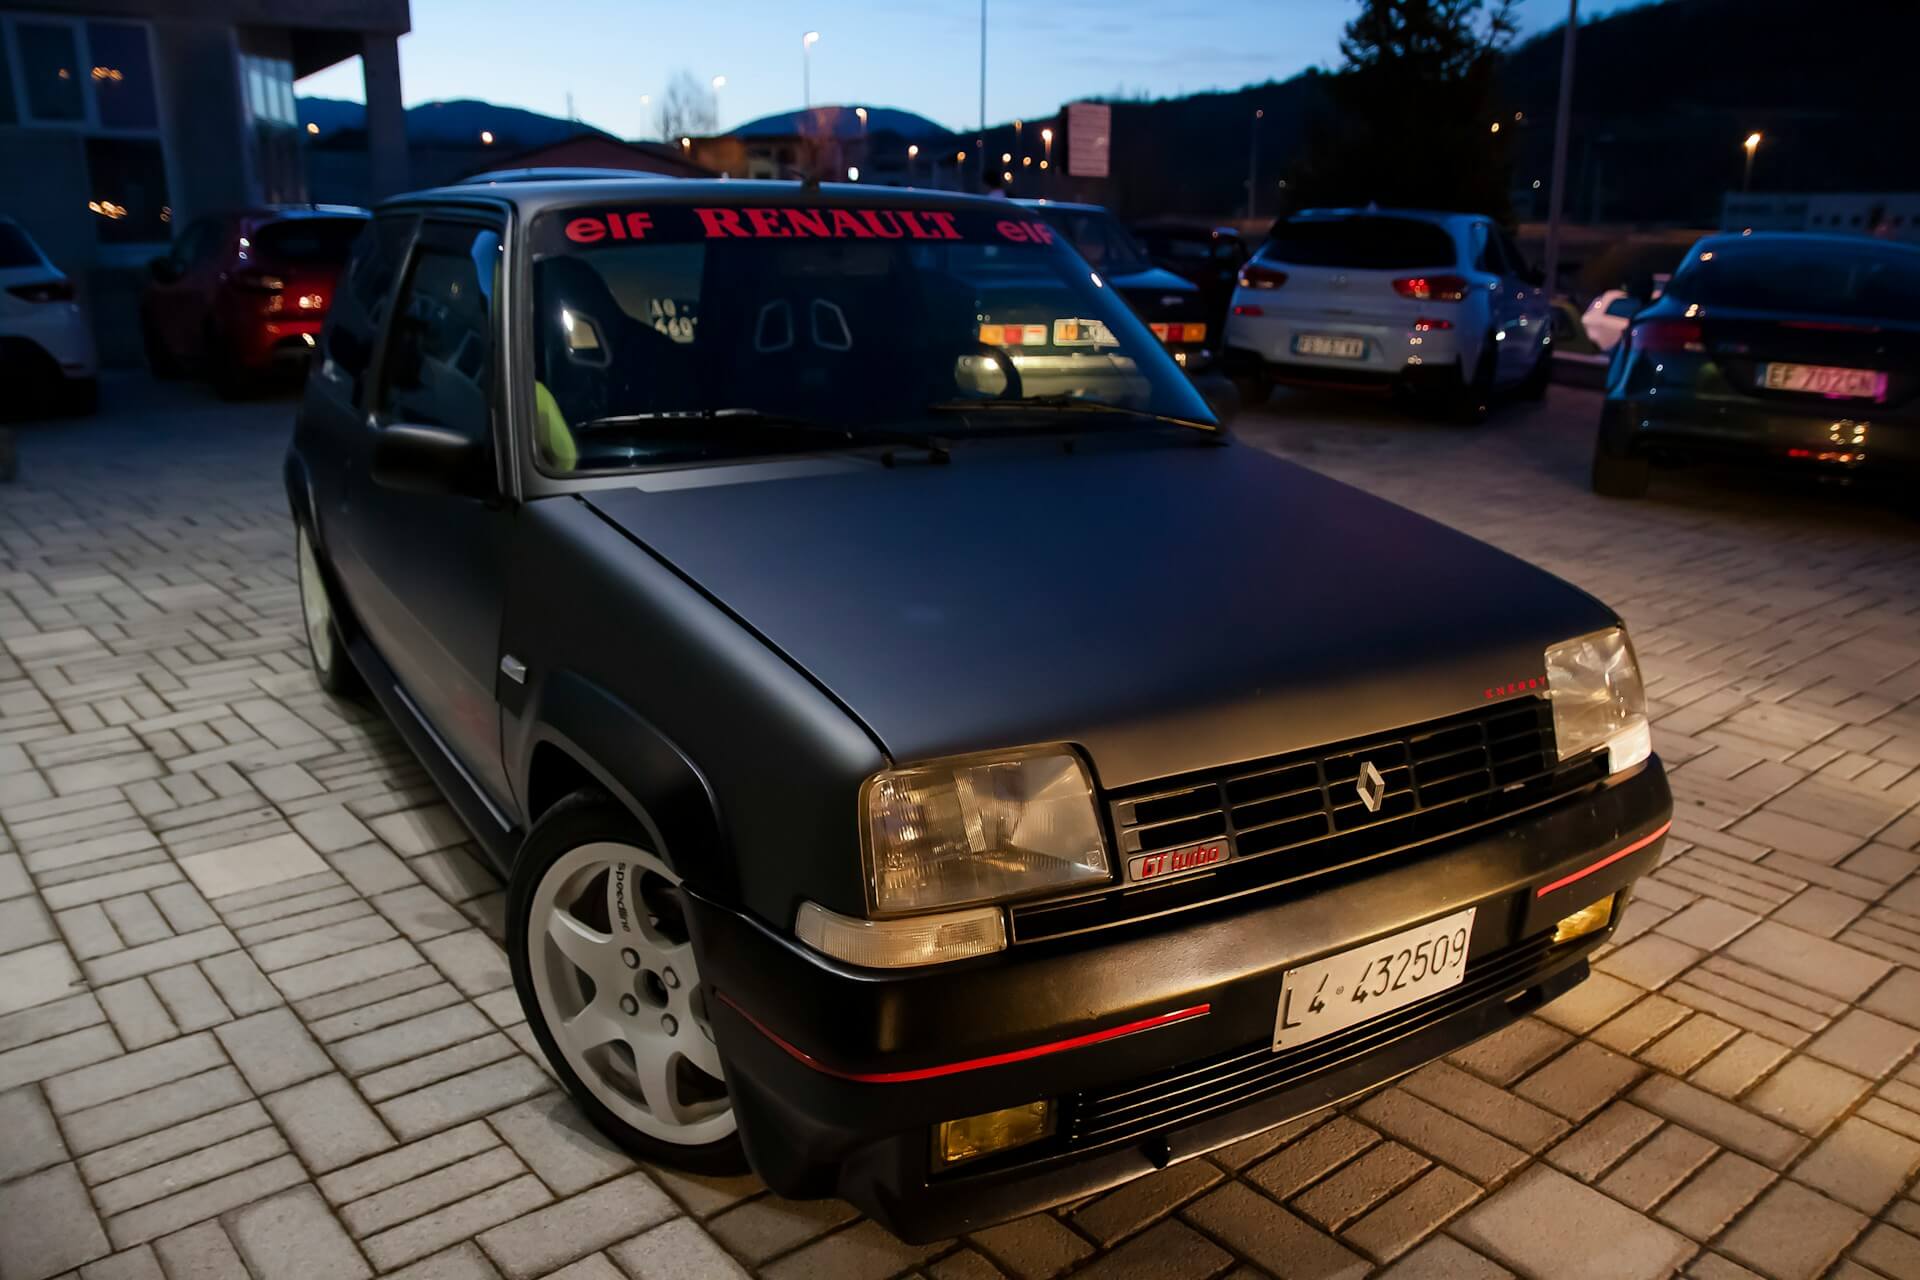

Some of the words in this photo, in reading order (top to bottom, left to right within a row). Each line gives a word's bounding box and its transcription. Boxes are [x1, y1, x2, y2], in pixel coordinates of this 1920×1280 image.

[565, 212, 654, 243] elf
[693, 207, 963, 240] RENAULT
[1141, 854, 1169, 879] GT
[1171, 844, 1219, 872] turbo
